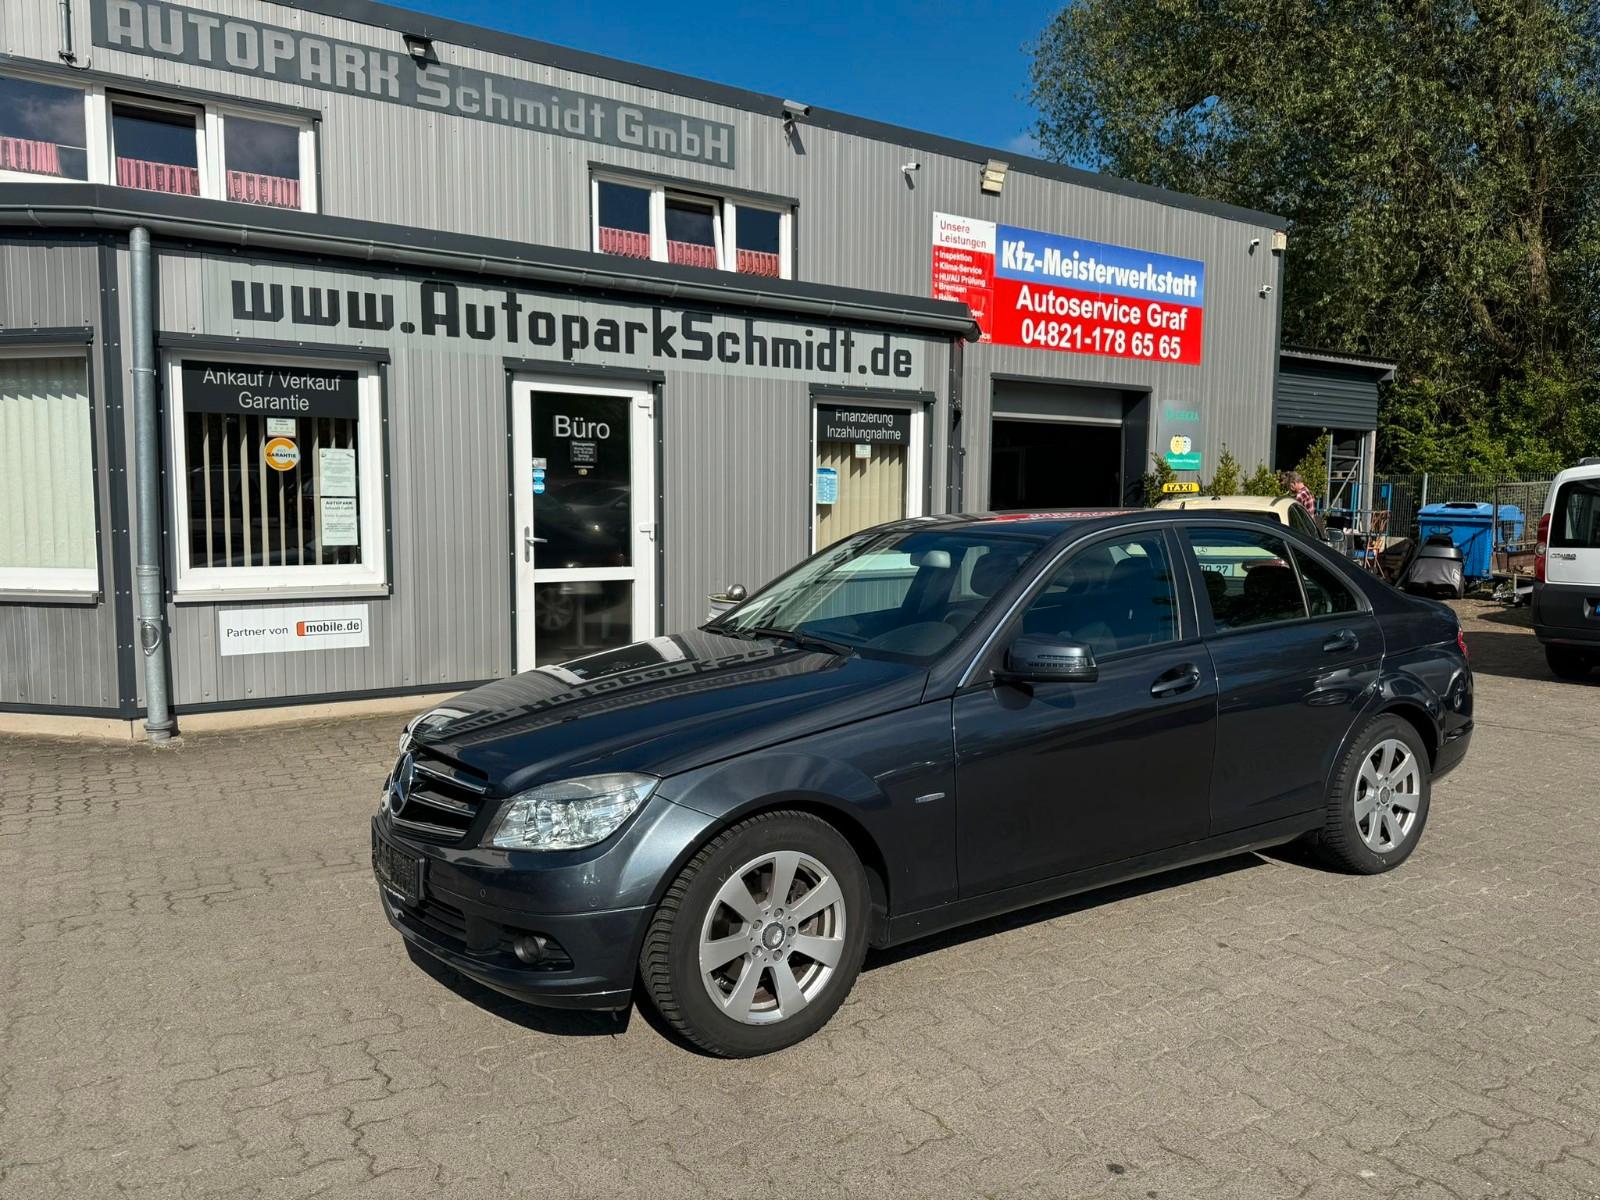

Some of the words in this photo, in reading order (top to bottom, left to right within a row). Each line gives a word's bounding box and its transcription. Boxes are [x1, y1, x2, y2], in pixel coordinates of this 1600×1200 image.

[107, 0, 400, 98] AUTOPARK
[416, 64, 605, 138] Schmidt
[617, 106, 729, 163] GmbH
[940, 220, 970, 234] Unsere
[940, 232, 987, 249] Leistungen
[939, 250, 973, 263] Inspektion
[939, 262, 983, 275] Klima-Service
[1001, 240, 1198, 298] Kfz-Meisterwerkstatt
[938, 283, 967, 293] Bremsen
[961, 275, 986, 287] Prüfung
[1016, 284, 1141, 325] Autoservice
[1146, 304, 1188, 331] Graf
[231, 280, 913, 378] www.AutoparkSchmidt.de
[1021, 318, 1125, 354] 04821-178
[1131, 332, 1154, 357] 65
[1158, 336, 1181, 360] 65
[203, 367, 264, 387] Ankauf
[279, 370, 341, 392] Verkauf
[238, 391, 310, 412] Garantie
[835, 409, 894, 427] Finanzierung
[554, 415, 610, 439] Büro
[827, 425, 901, 442] Inzahlungnahme
[1169, 484, 1192, 492] TAXI
[227, 628, 265, 638] Partner
[269, 627, 289, 635] von
[306, 621, 360, 633] mobile.de
